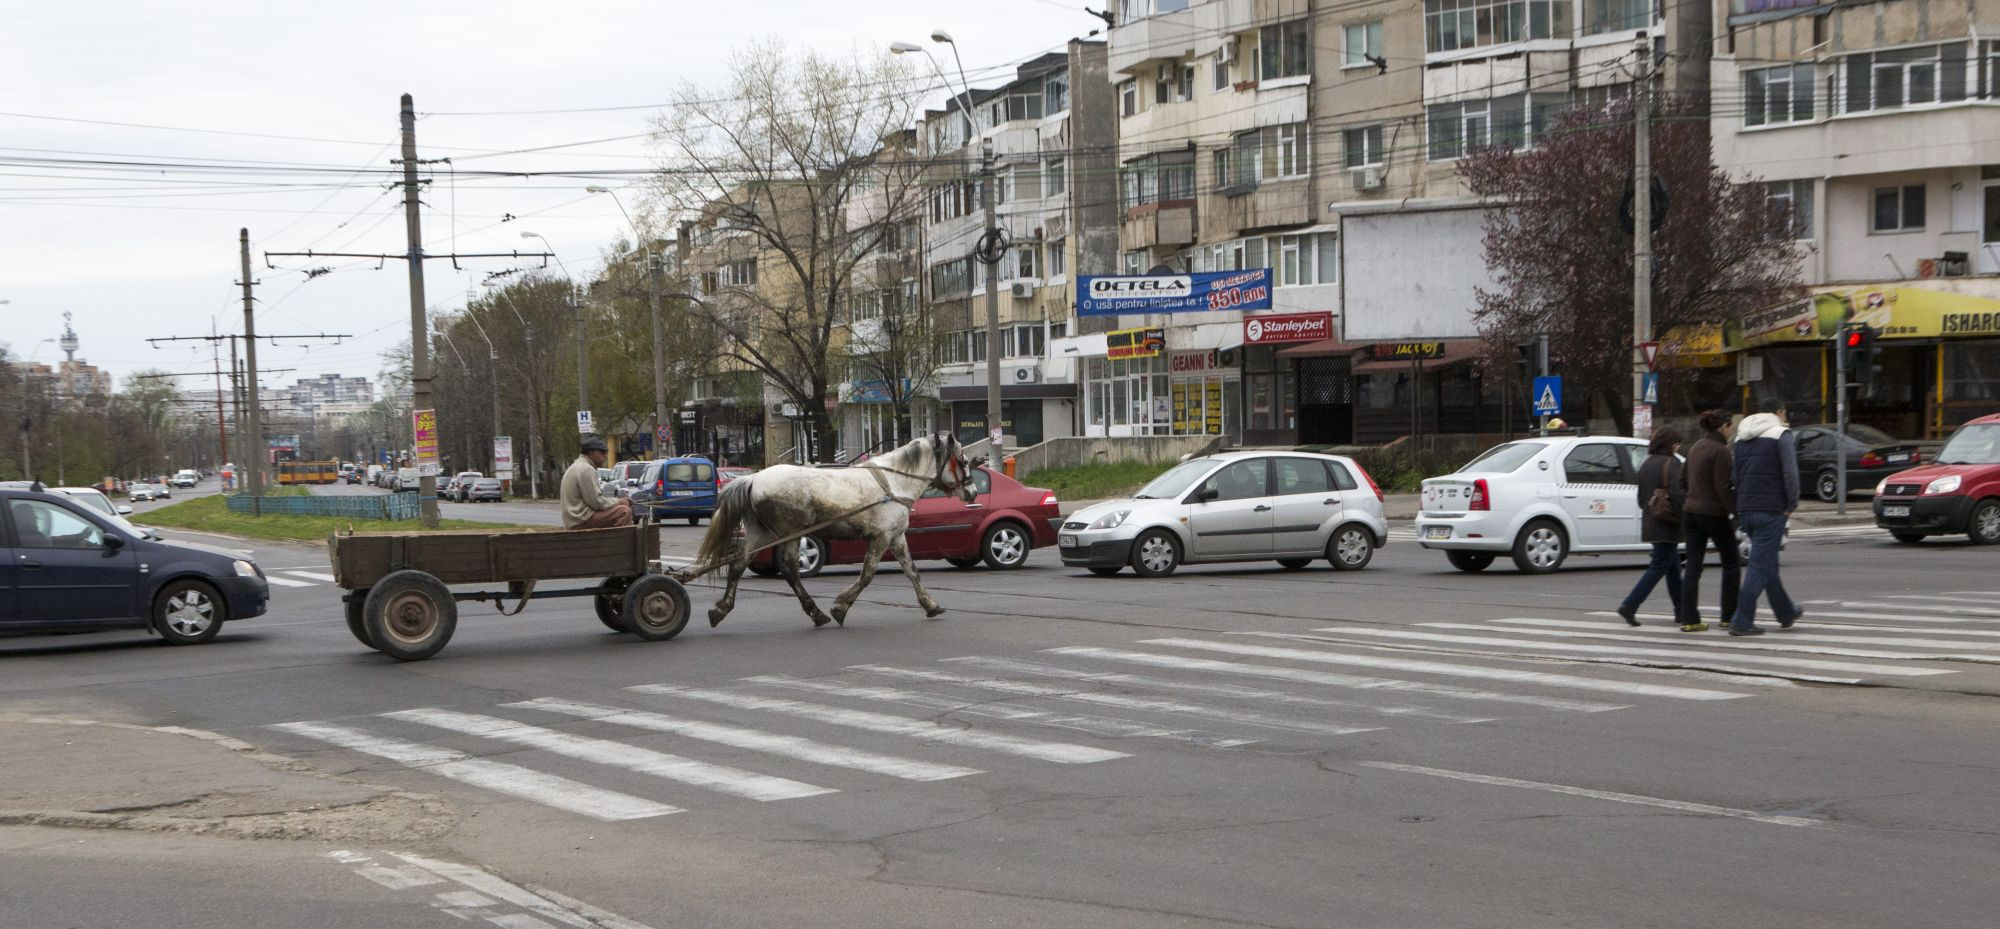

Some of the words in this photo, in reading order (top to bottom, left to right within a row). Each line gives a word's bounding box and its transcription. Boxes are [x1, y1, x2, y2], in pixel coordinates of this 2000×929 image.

[1094, 279, 1186, 292] OCTELA
[1096, 290, 1185, 298] multiconfort
[1206, 286, 1242, 311] 350
[1242, 285, 1267, 304] RON
[1083, 300, 1092, 310] O
[1115, 299, 1147, 311] pentru
[1186, 297, 1196, 306] ta
[1263, 318, 1324, 333] Stanleybet
[1173, 354, 1204, 372] GEANNI
[580, 412, 588, 420] H
